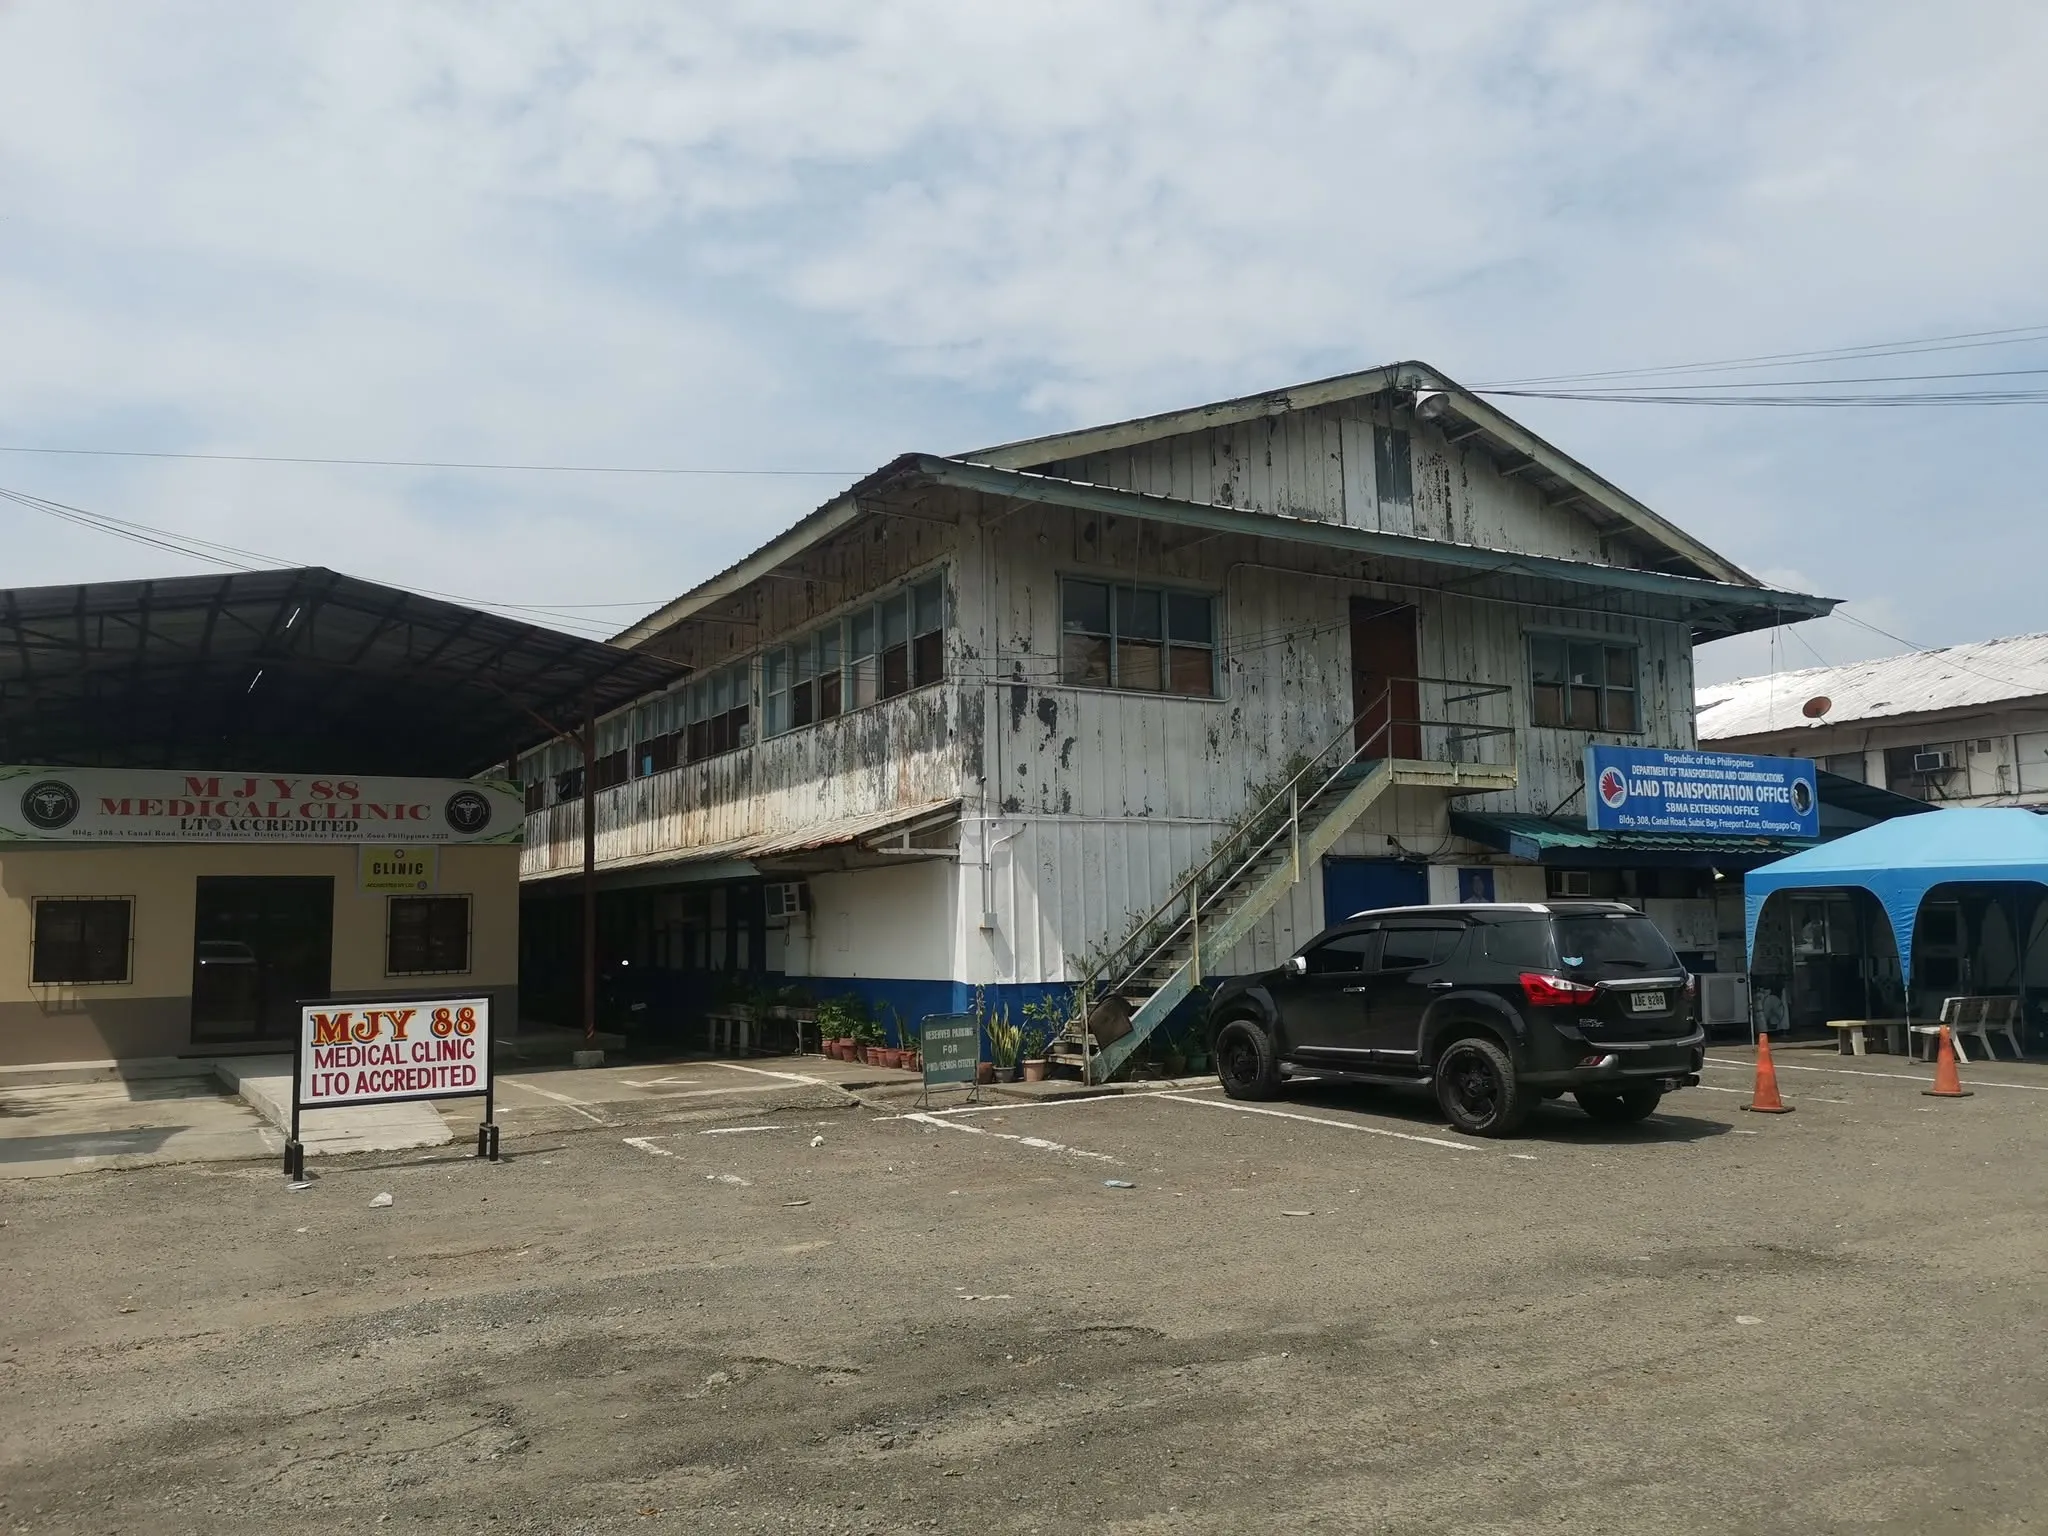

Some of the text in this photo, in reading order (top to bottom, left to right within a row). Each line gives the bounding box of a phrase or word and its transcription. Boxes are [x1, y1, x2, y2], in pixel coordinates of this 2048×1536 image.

[1664, 753, 1754, 769] Republic of the Philippines
[1632, 765, 1784, 783] DEPARTMENT OF TRANSPORTATION AND COMMUNICATIONS
[310, 780, 359, 801] 88
[1628, 779, 1790, 804] LAND TRANSPORTATION OFFICE
[97, 798, 291, 818] MEDICAL
[300, 802, 431, 820] CLINIC
[1666, 802, 1760, 816] SBMA EXTENSION OFFICE
[228, 819, 359, 832] ACCREDITED
[1619, 815, 1801, 832] Bldg. 308, Canal Road, Subic Bay, Freeport Zone, Olongapo City
[182, 830, 212, 838] Central
[331, 832, 364, 840] Freeport
[388, 832, 430, 841] Philippines
[373, 862, 424, 875] CLINIC
[310, 1006, 477, 1048] MJY 88
[926, 1027, 974, 1040] RESERVED PARKING
[314, 1037, 476, 1069] MEDICAL CLINIC
[942, 1044, 958, 1054] FOR
[312, 1064, 477, 1097] LTO ACCREDITED
